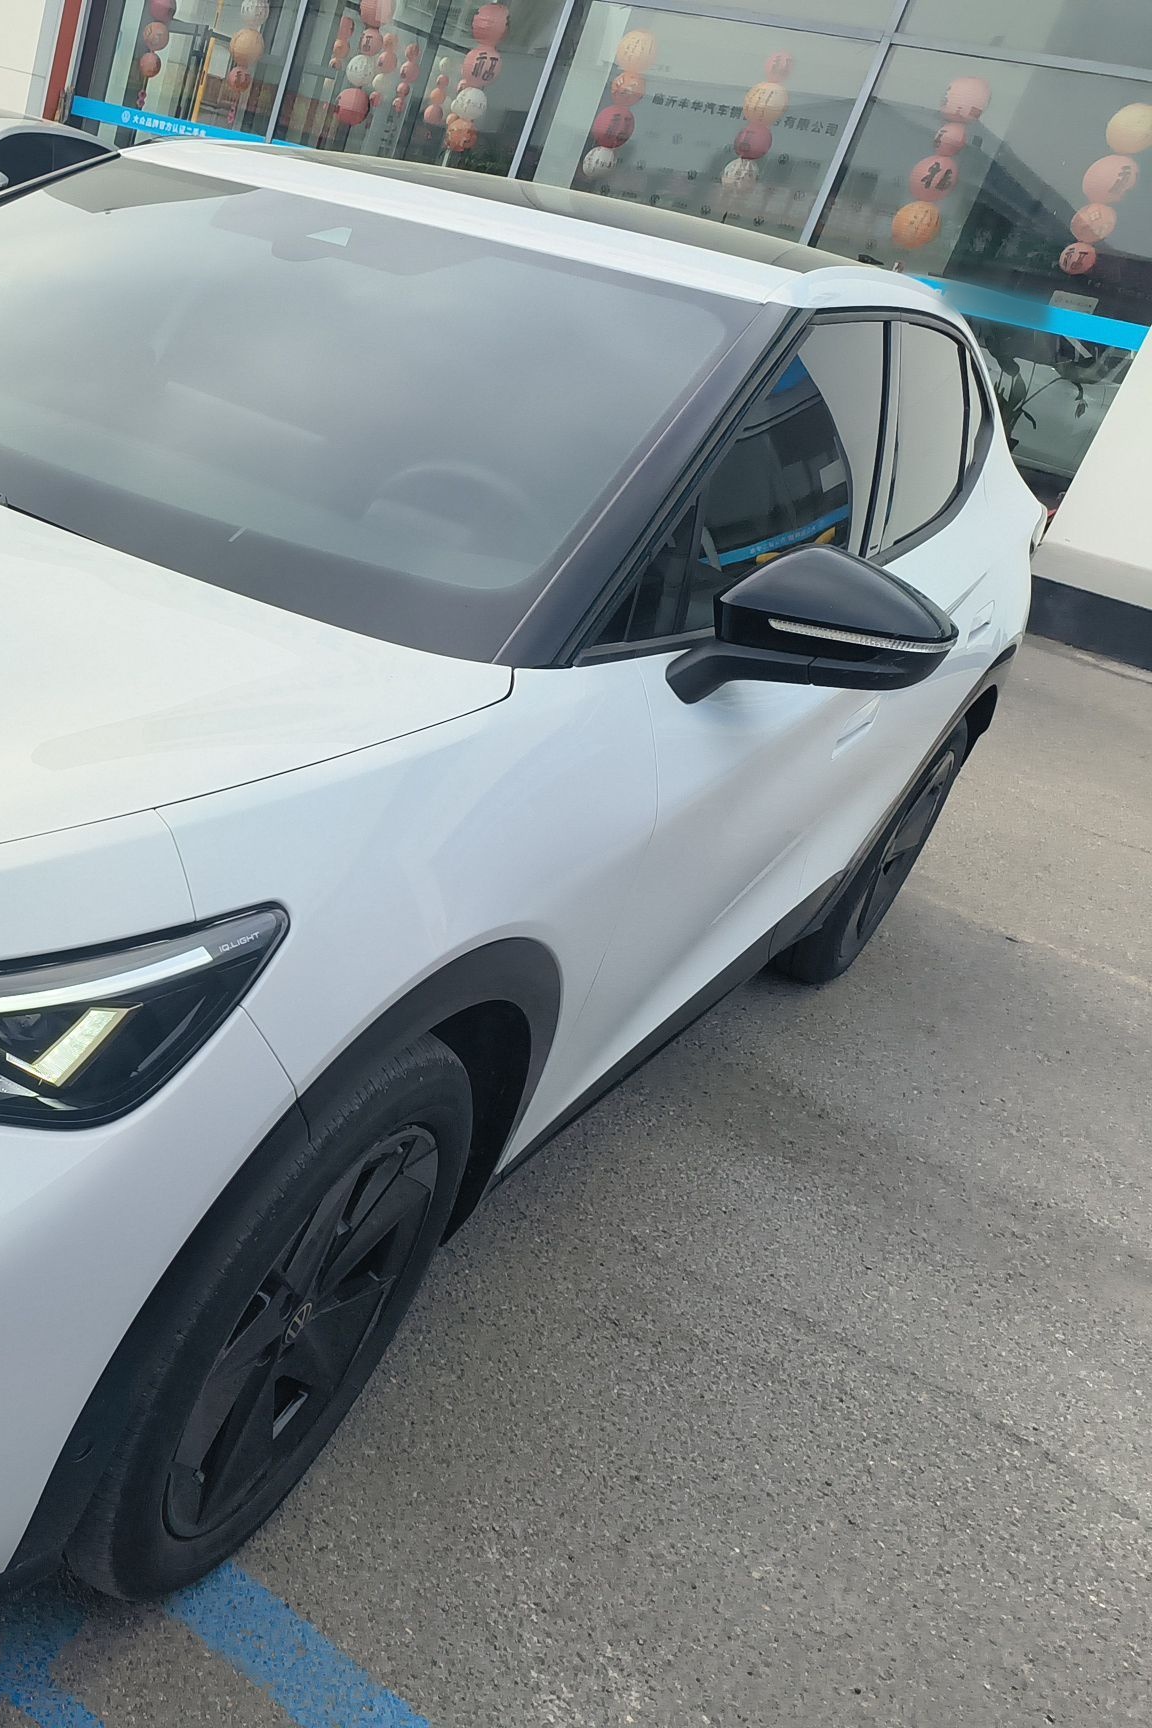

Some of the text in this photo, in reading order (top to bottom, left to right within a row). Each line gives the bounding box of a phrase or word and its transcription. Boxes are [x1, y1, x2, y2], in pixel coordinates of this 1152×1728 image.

[651, 93, 840, 137] 临沂丰华汽车销有限公司
[218, 931, 260, 953] IQ.LIGHT
